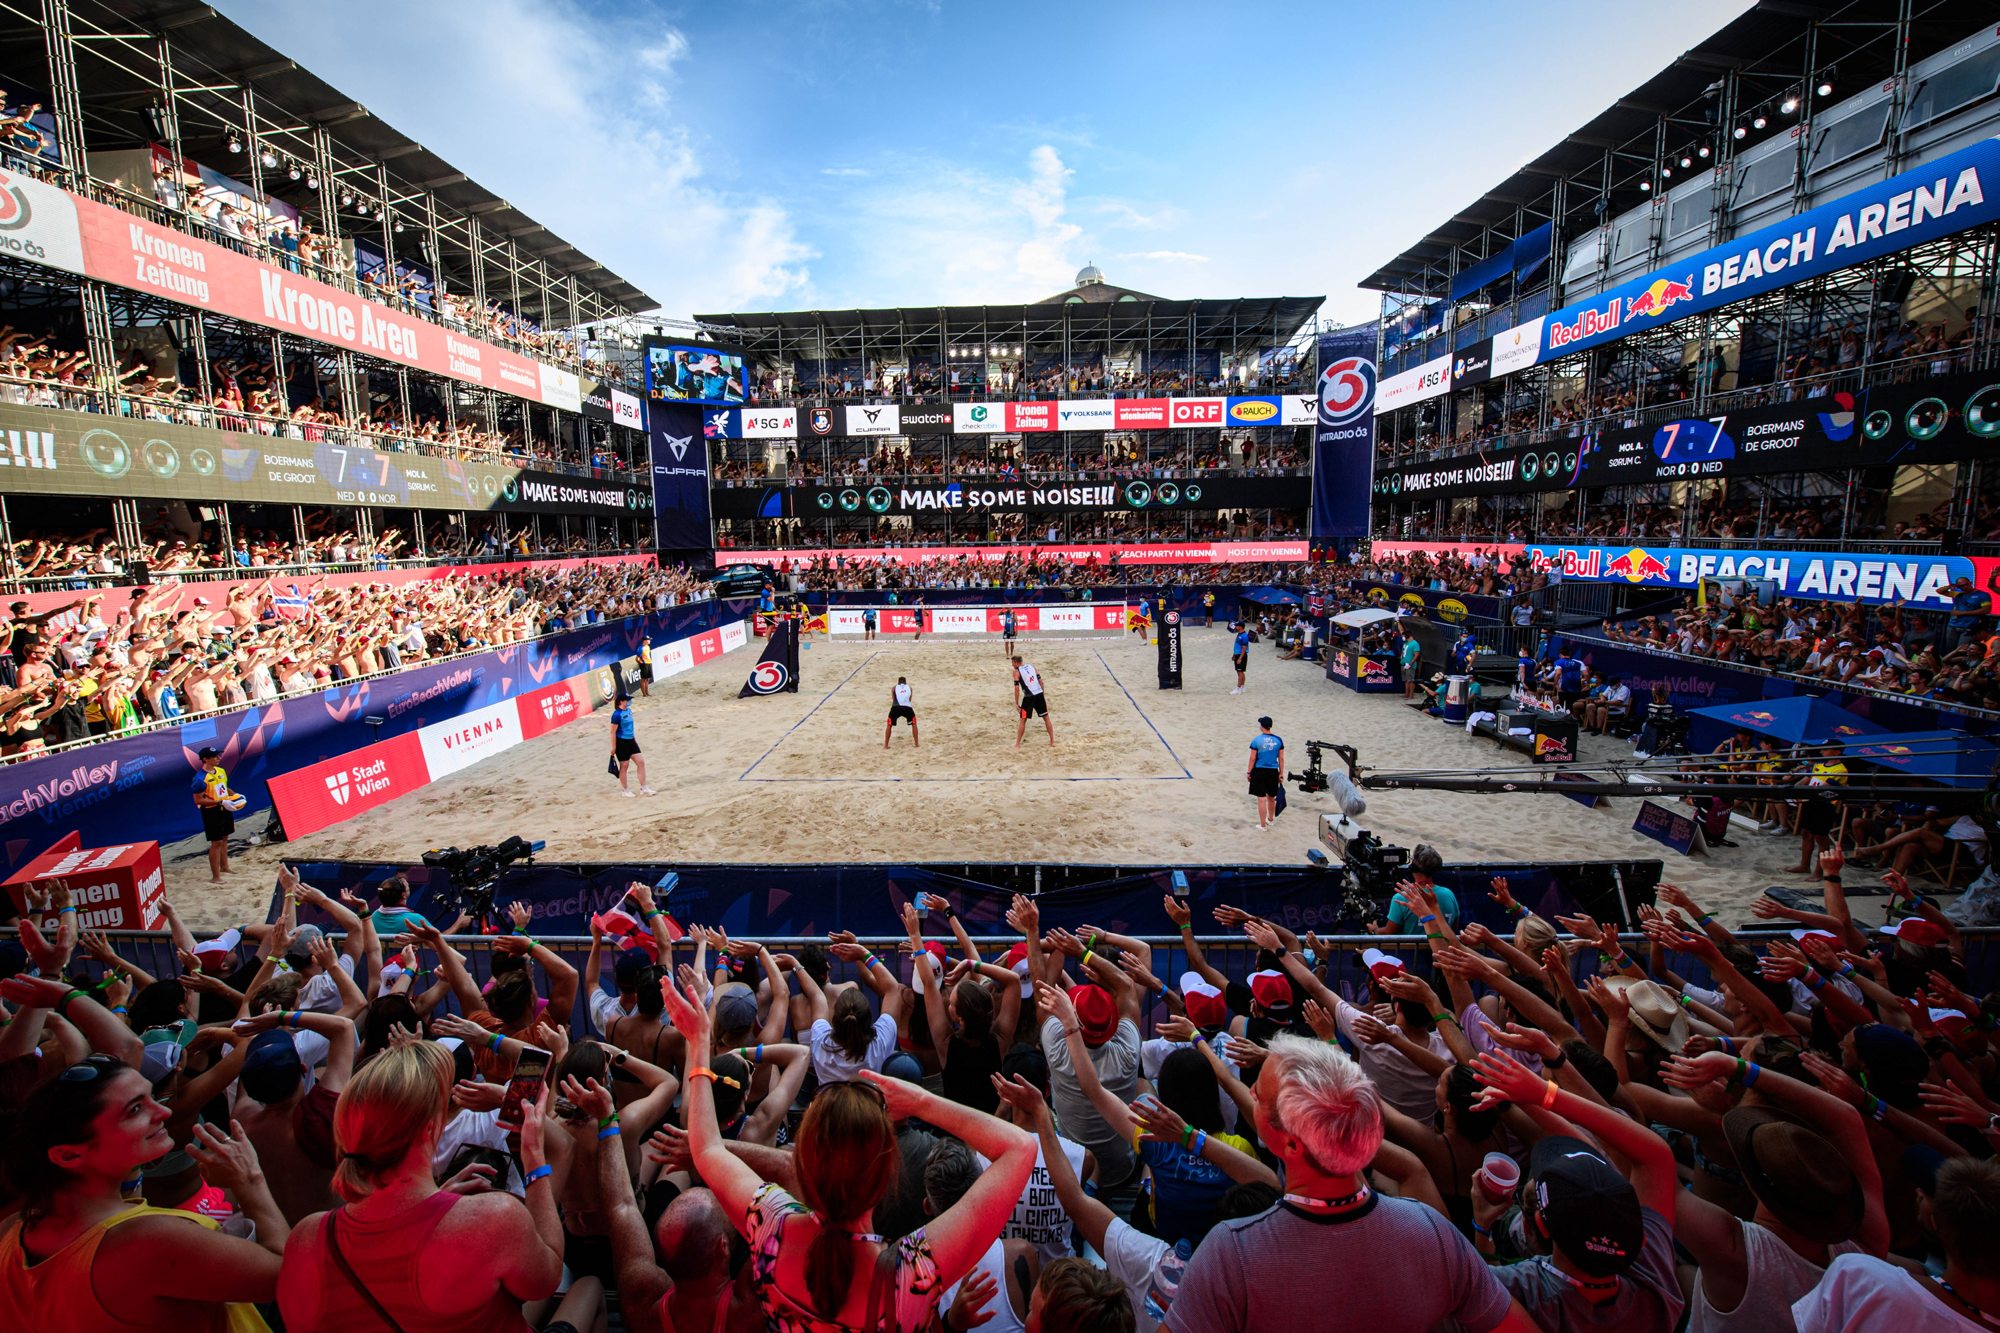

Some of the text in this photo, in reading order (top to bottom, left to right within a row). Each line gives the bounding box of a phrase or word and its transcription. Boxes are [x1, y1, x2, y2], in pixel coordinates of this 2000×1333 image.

[1702, 165, 1985, 296] BEACH ARENA
[24, 240, 46, 258] Ö3
[129, 222, 206, 272] Kronen
[134, 254, 210, 302] Zeitung
[260, 268, 418, 360] Krone Area
[446, 334, 480, 362] Kronen
[448, 349, 482, 382] Zeitung
[1426, 372, 1438, 387] 5G
[1441, 365, 1450, 383] A1
[581, 393, 607, 410] swatch
[651, 389, 665, 399] DJ
[622, 406, 632, 418] 5G
[1015, 404, 1047, 416] Kronen
[1177, 405, 1219, 419] ORF
[1243, 406, 1272, 415] RAUCH
[747, 417, 793, 429] A1 5G A1
[902, 413, 944, 424] swatch
[1015, 416, 1048, 429] Zeitung
[1319, 426, 1368, 442] HITRADIO Ö3
[1747, 420, 1805, 436] BOERMANS
[1661, 424, 1681, 459] 7
[1707, 416, 1727, 453] 7
[1745, 437, 1800, 452] DE GROOT
[1618, 442, 1644, 452] MOL A.
[264, 454, 314, 468] BOERMANS
[331, 449, 348, 482] 7
[374, 454, 390, 486] 7
[1608, 456, 1642, 468] SØRUM C.
[406, 470, 420, 478] MOL
[655, 466, 706, 476] CUPRA
[1404, 460, 1515, 492] MAKE SOME NOISE!!!
[1656, 466, 1676, 477] NOR
[1702, 462, 1723, 473] NED
[269, 472, 316, 484] DE GROOT
[337, 491, 355, 501] NED
[378, 494, 396, 503] NOR
[523, 481, 624, 507] MAKE SOME NOISE!!!
[900, 486, 1114, 510] MAKE SOME NOISE!!!
[1185, 549, 1217, 557] VIENNA
[1228, 547, 1303, 557] HOST CITY VIENNA
[1798, 560, 1954, 604] ARENA
[664, 650, 681, 664] WIEN
[387, 668, 472, 719] EuroBeachVolley
[554, 690, 572, 706] Stadt
[556, 702, 574, 716] Wien
[444, 717, 503, 749] VIENNA
[352, 758, 386, 782] Stadt
[116, 770, 144, 792] 2021
[355, 774, 391, 797] Wien
[138, 866, 162, 905] Kronen
